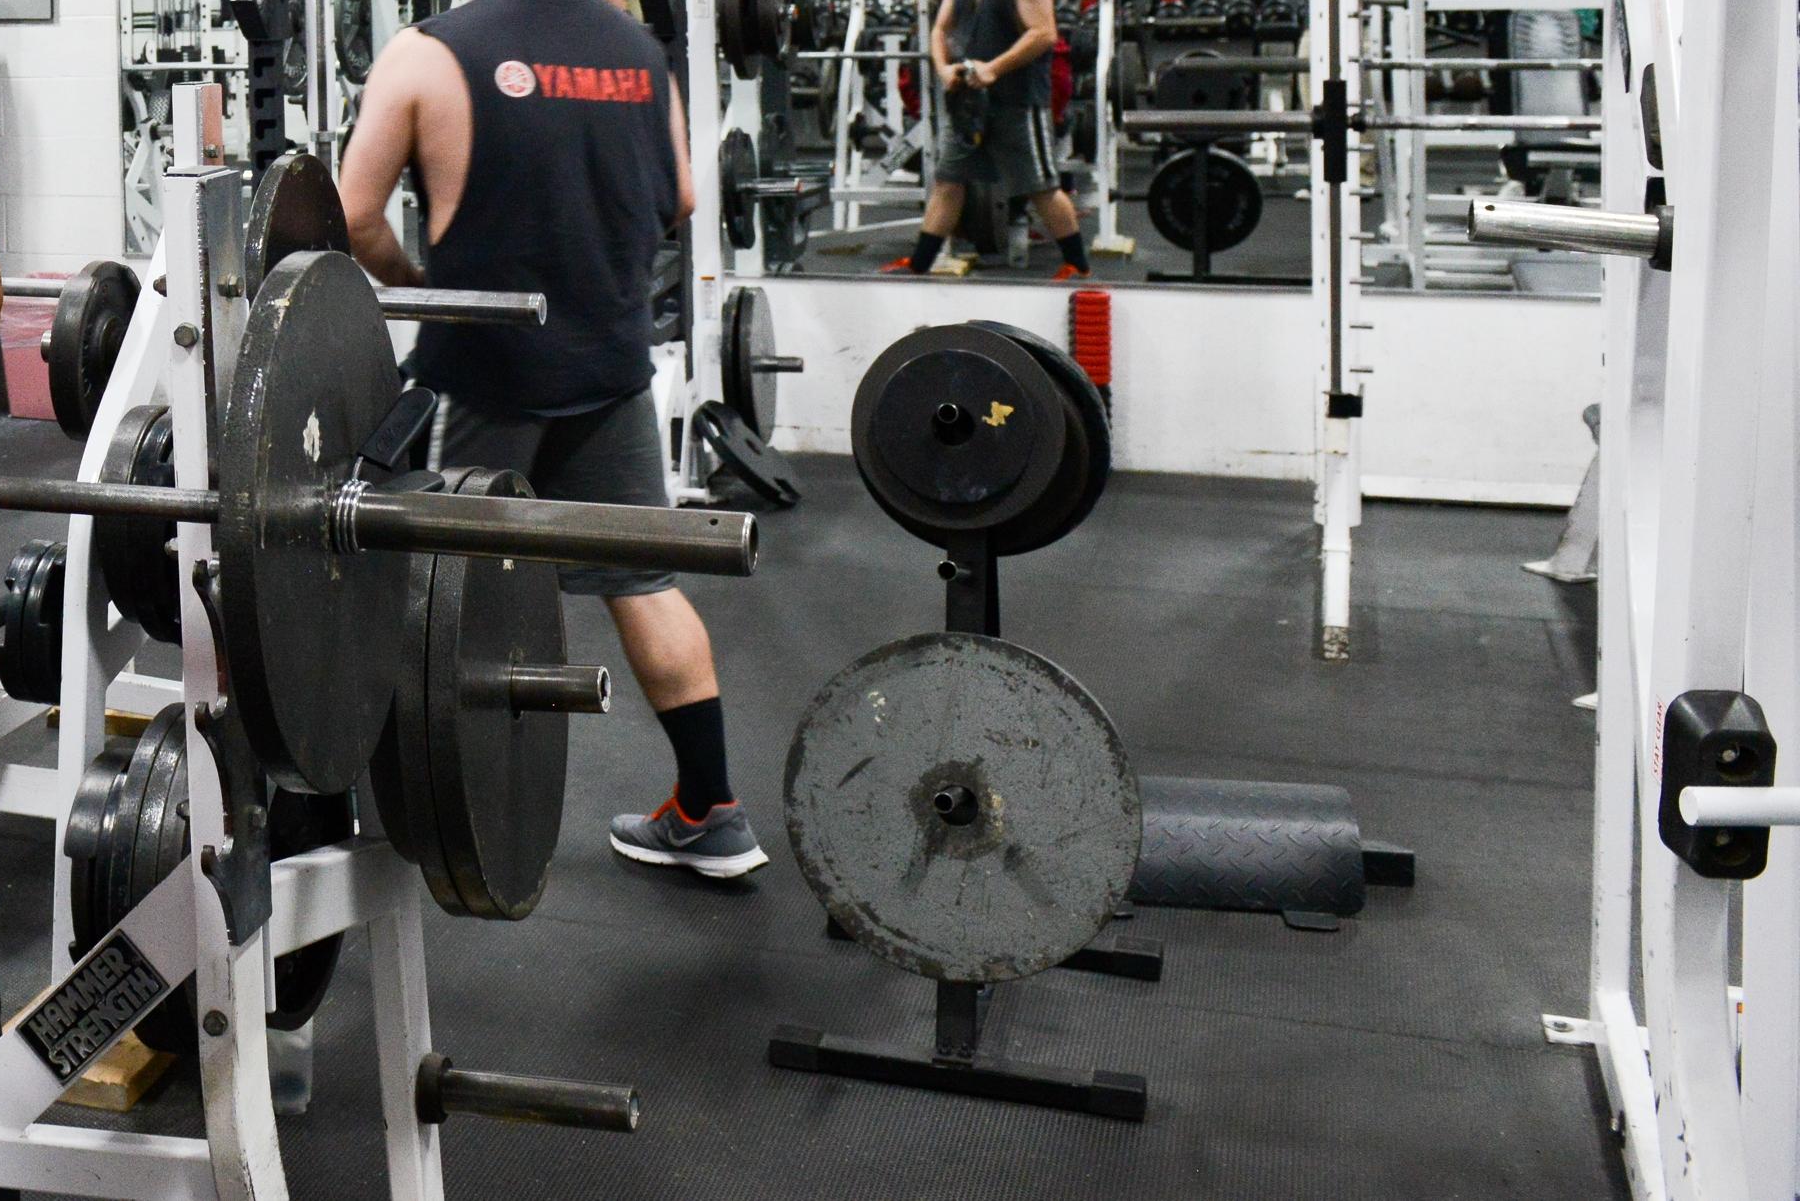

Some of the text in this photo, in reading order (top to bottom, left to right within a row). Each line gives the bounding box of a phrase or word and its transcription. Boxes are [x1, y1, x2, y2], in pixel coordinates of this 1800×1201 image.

[532, 63, 653, 103] YAMAHA
[27, 947, 131, 1049] HAMMER
[48, 966, 159, 1076] STRENGTH
